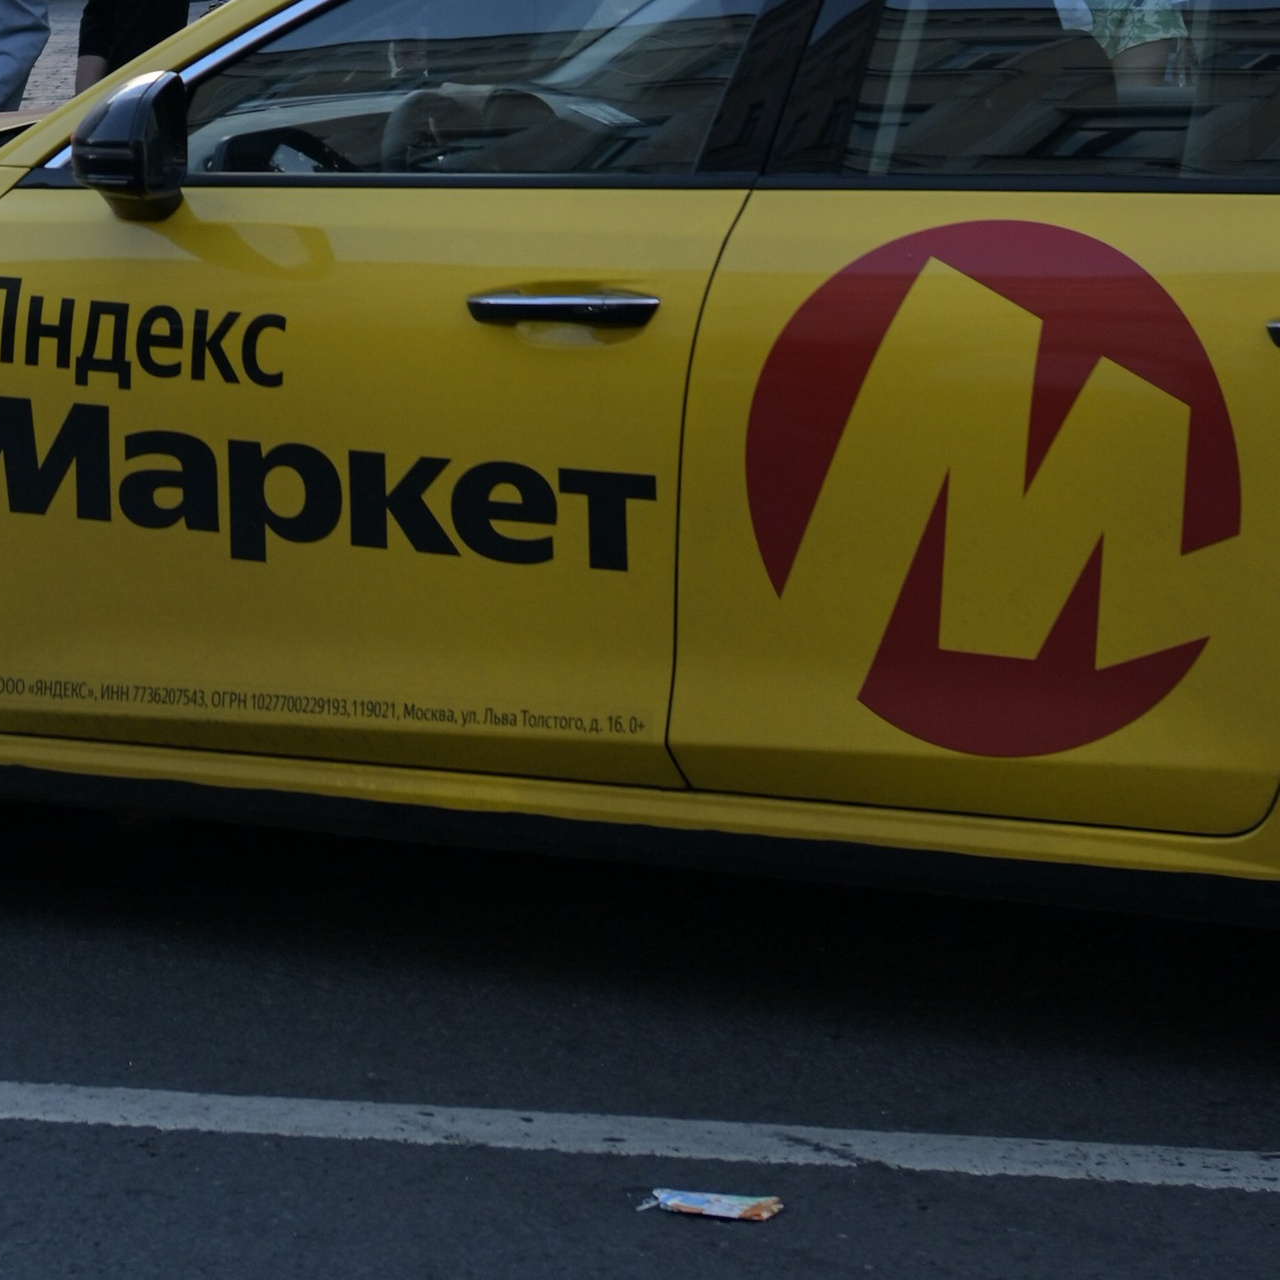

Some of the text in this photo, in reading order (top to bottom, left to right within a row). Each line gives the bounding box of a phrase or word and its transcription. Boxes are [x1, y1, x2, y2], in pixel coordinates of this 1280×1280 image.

[28, 679, 97, 702] «ЯНДЕКС»,
[100, 684, 129, 702] ИНН
[132, 685, 208, 709] 7736207543,
[211, 690, 247, 710] ОГРН
[403, 702, 458, 724] Москва,
[461, 710, 480, 727] ул.
[483, 708, 517, 727] Льва
[521, 710, 587, 733] Толстого,
[589, 719, 603, 734] д.
[629, 716, 645, 734] 0+
